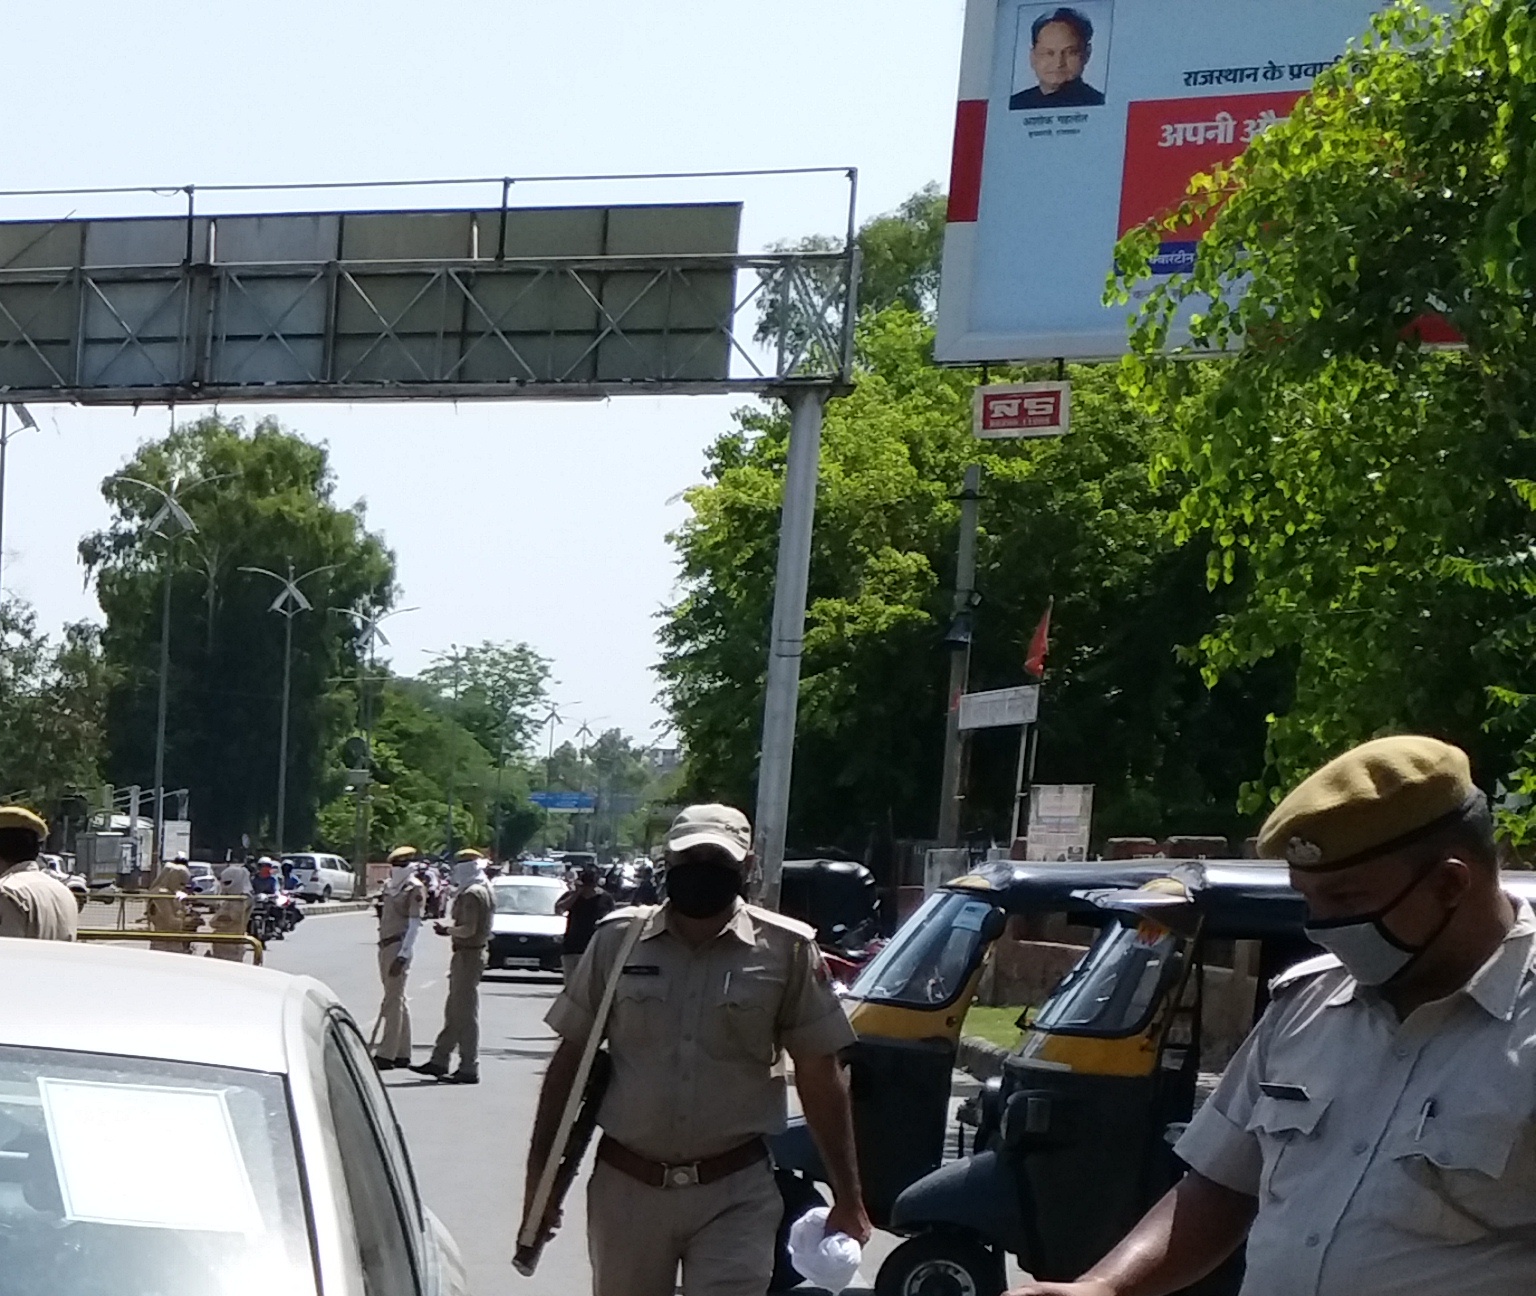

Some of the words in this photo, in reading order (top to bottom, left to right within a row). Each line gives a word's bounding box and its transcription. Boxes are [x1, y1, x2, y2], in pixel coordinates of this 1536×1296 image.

[1183, 66, 1259, 87] राजस्थान
[1262, 60, 1284, 82] के
[1158, 111, 1237, 147] अपनी
